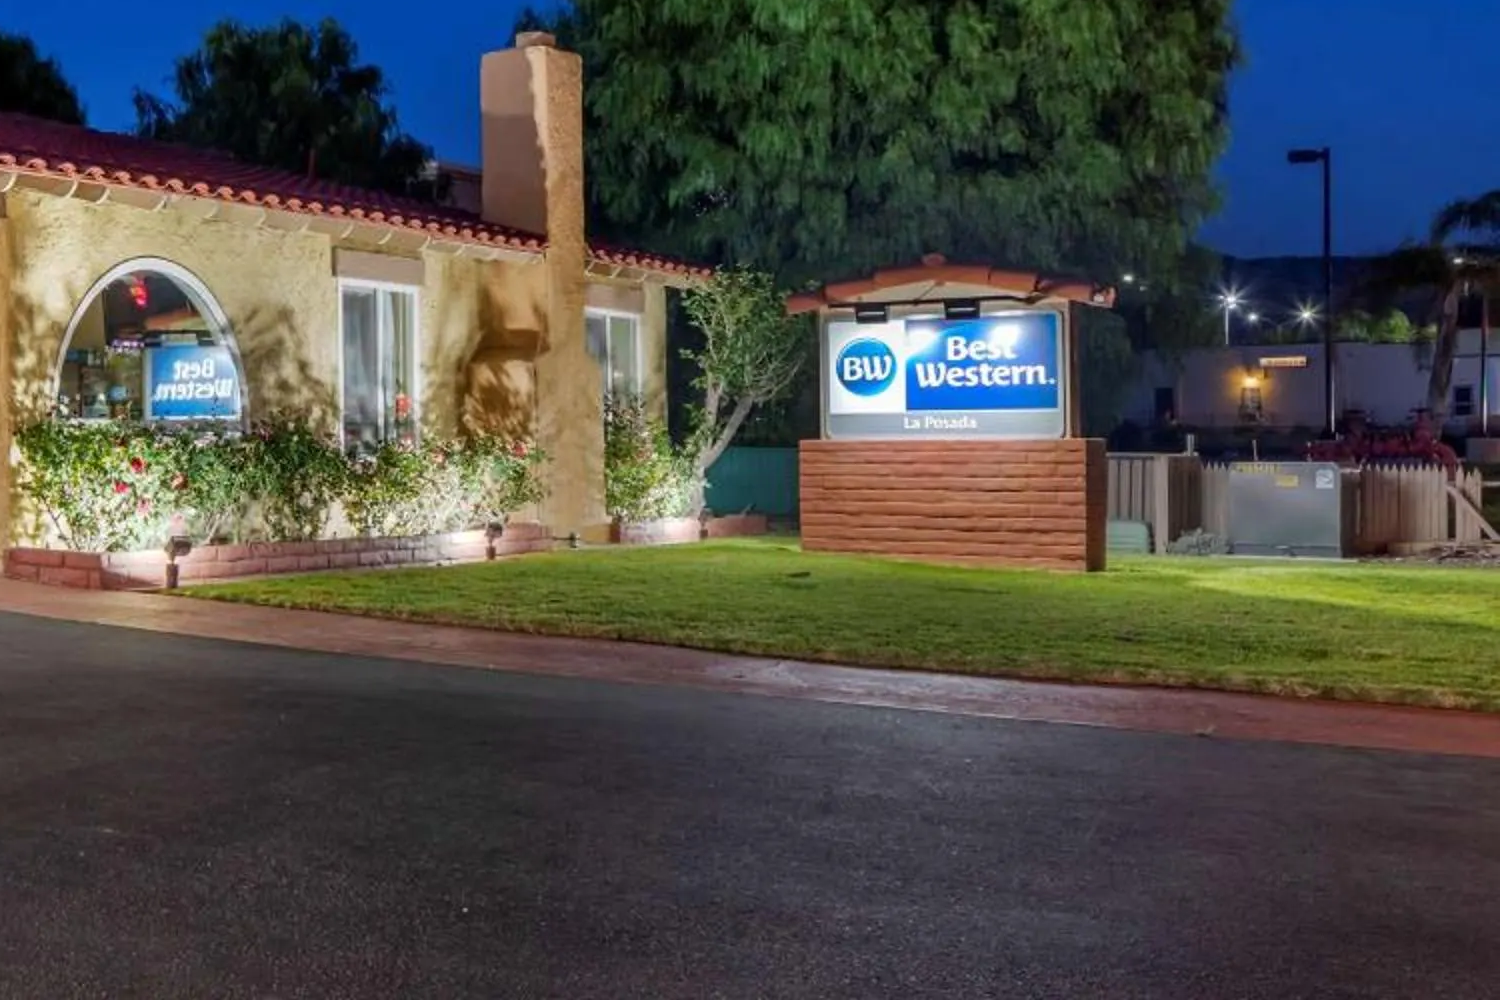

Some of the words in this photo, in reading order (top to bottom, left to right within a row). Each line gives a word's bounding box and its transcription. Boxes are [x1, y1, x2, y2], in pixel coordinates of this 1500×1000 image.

[946, 335, 1017, 361] Best
[843, 355, 892, 381] BW
[903, 417, 921, 429] La
[925, 416, 977, 429] Posada
